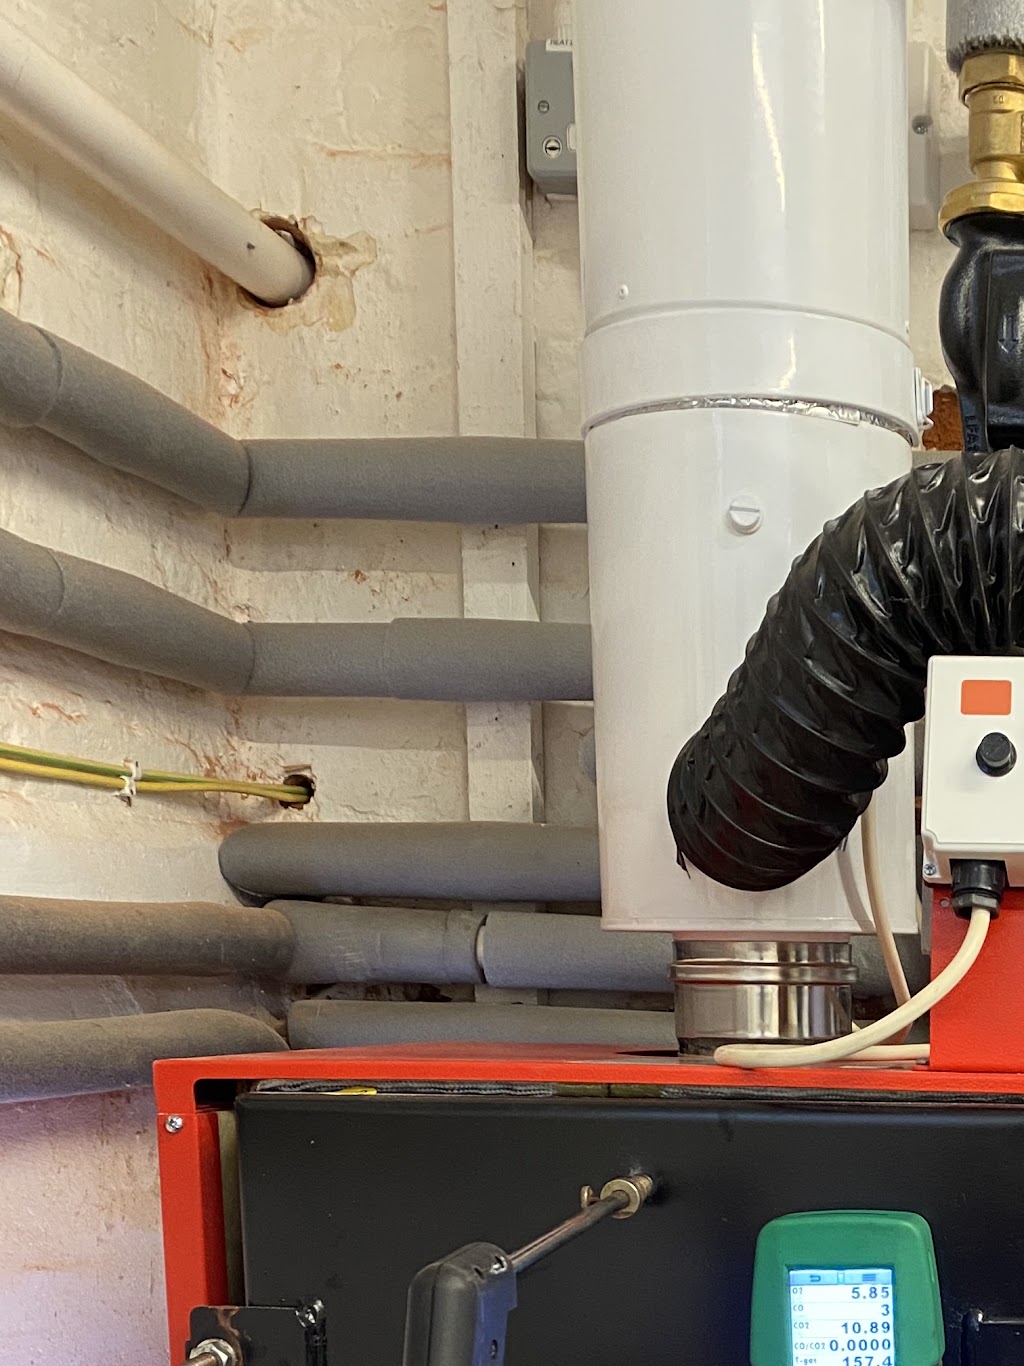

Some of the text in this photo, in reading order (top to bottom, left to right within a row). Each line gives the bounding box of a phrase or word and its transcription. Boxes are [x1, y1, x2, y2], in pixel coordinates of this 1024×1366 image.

[852, 1286, 890, 1299] 5.85
[793, 1304, 890, 1316] CO 3
[793, 1322, 891, 1334] CO2 10.89
[794, 1339, 891, 1352] CO/CO2 0.0000
[795, 1357, 817, 1366] T-gas
